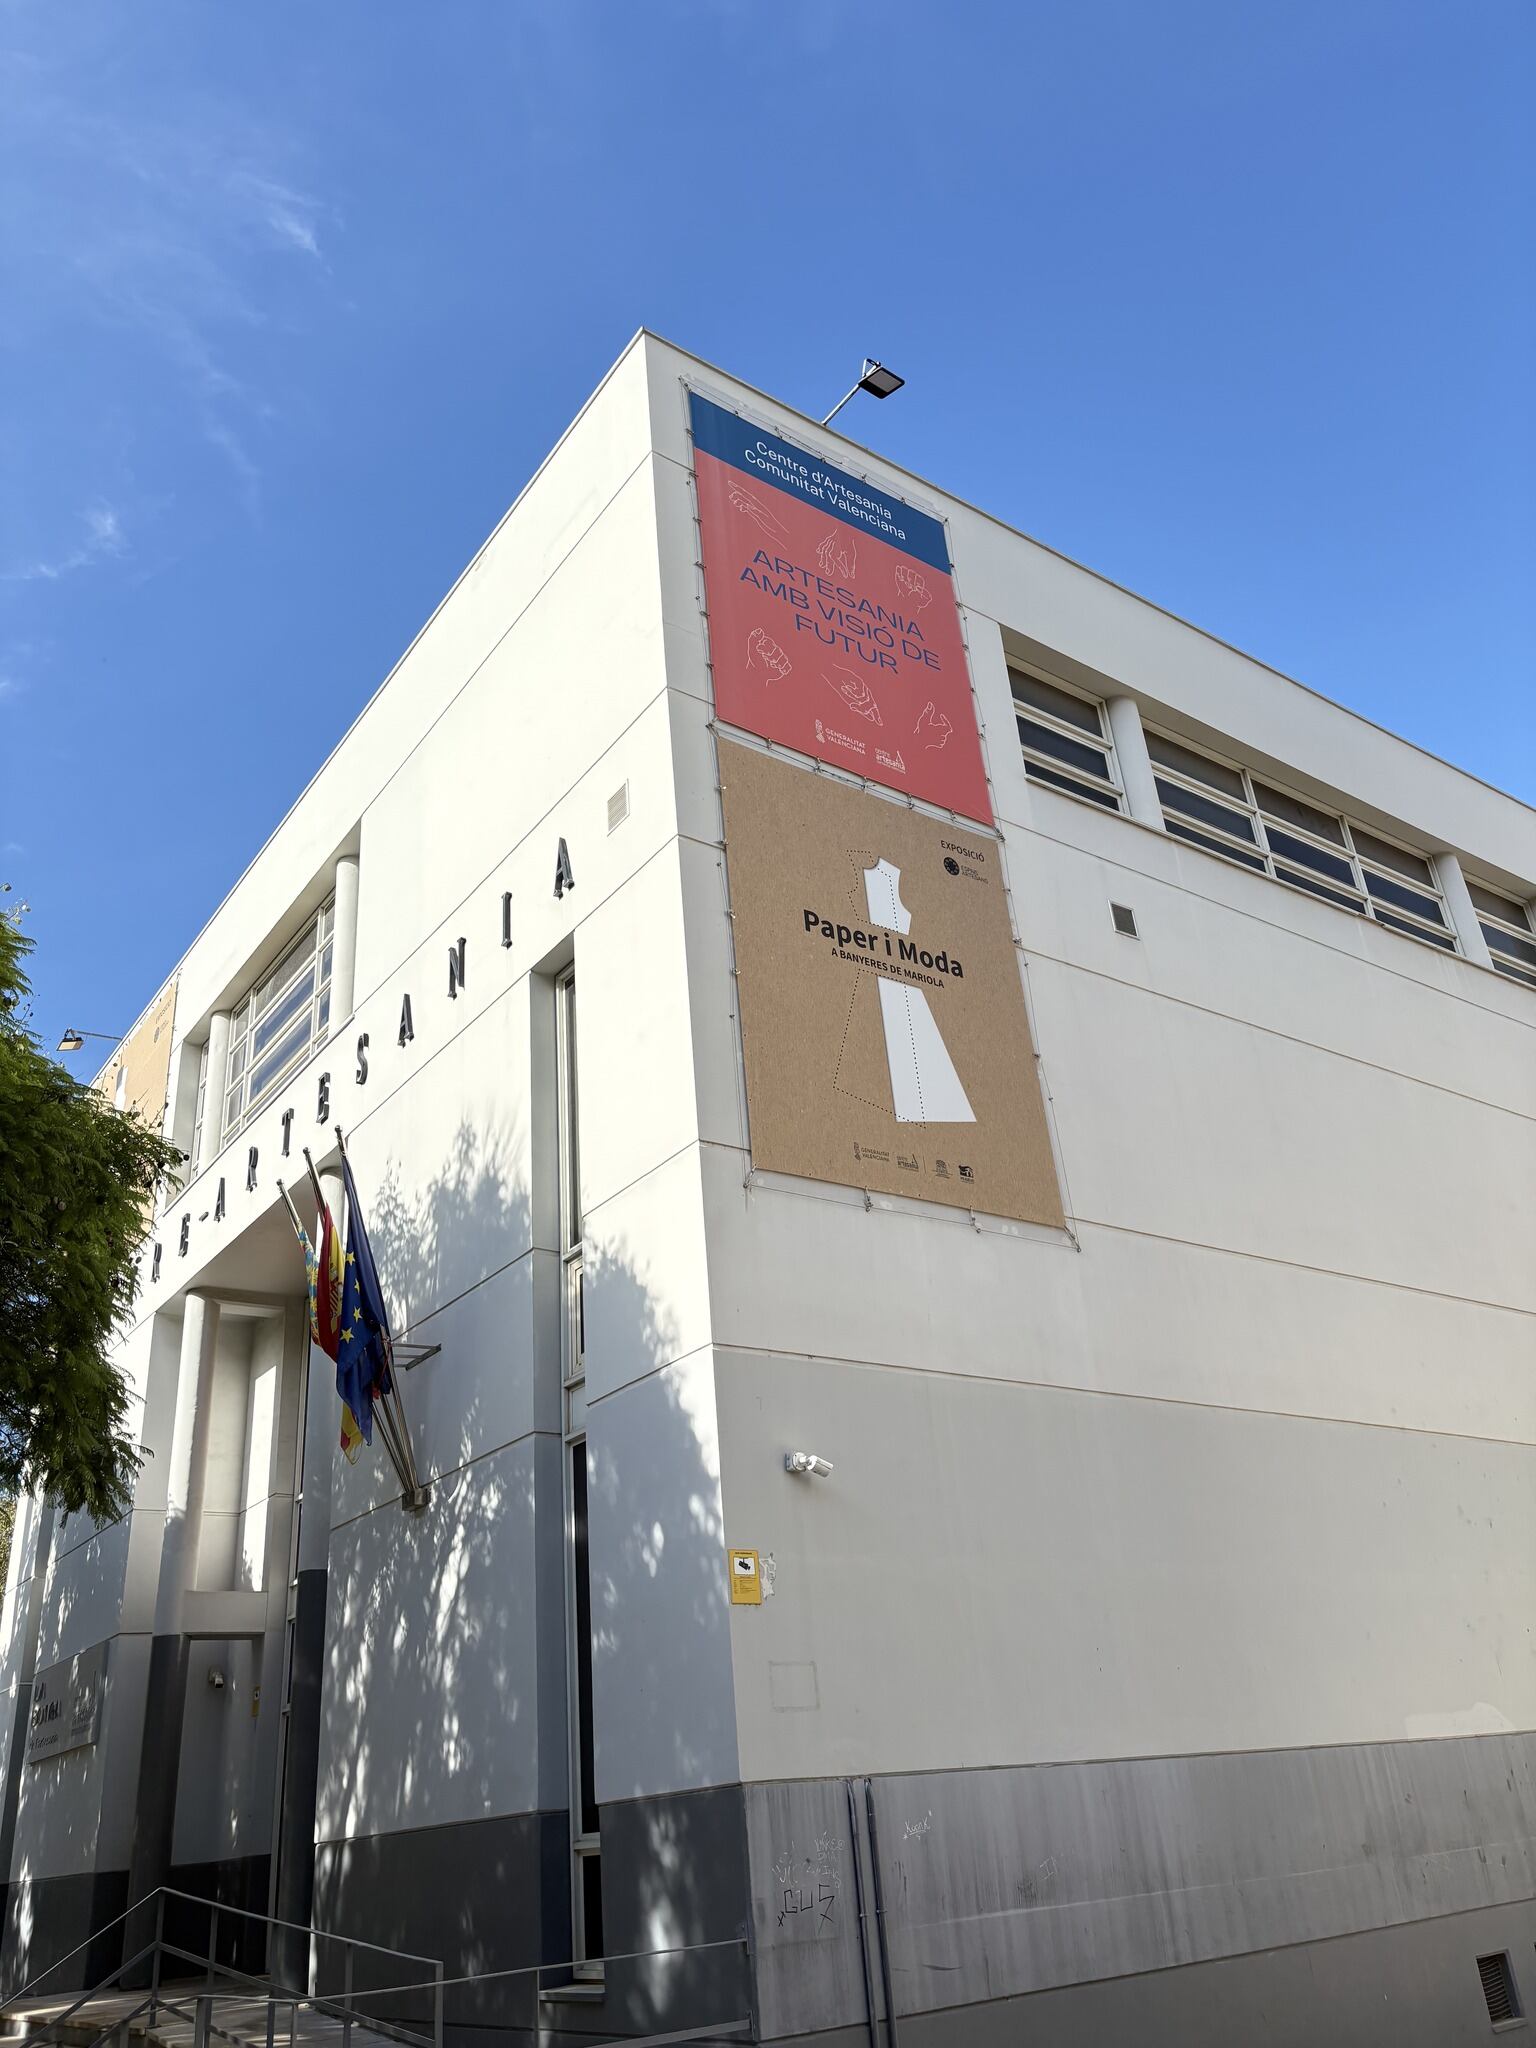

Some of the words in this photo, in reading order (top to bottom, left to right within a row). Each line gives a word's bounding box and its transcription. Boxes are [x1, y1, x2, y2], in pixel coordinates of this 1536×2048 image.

[744, 449, 825, 499] Comunitat
[827, 492, 906, 540] Valenciana
[756, 441, 808, 477] Centre
[812, 471, 892, 520] d'Artesania
[740, 567, 810, 610] AMB
[817, 599, 895, 648] VISIÓ
[902, 639, 942, 671] DE
[753, 550, 925, 641] ARTESANIA
[795, 614, 899, 674] FUTUR
[825, 728, 866, 748] GENERALITAT
[826, 735, 866, 755] VALENCIANA
[941, 840, 984, 862] EXPOSICIÓ
[803, 909, 878, 951] Paper
[884, 932, 892, 956] i
[898, 938, 964, 978] Moda
[831, 947, 838, 958] A
[840, 949, 888, 971] BANYERES
[890, 964, 902, 976] DE
[904, 968, 945, 989] MARIOLA
